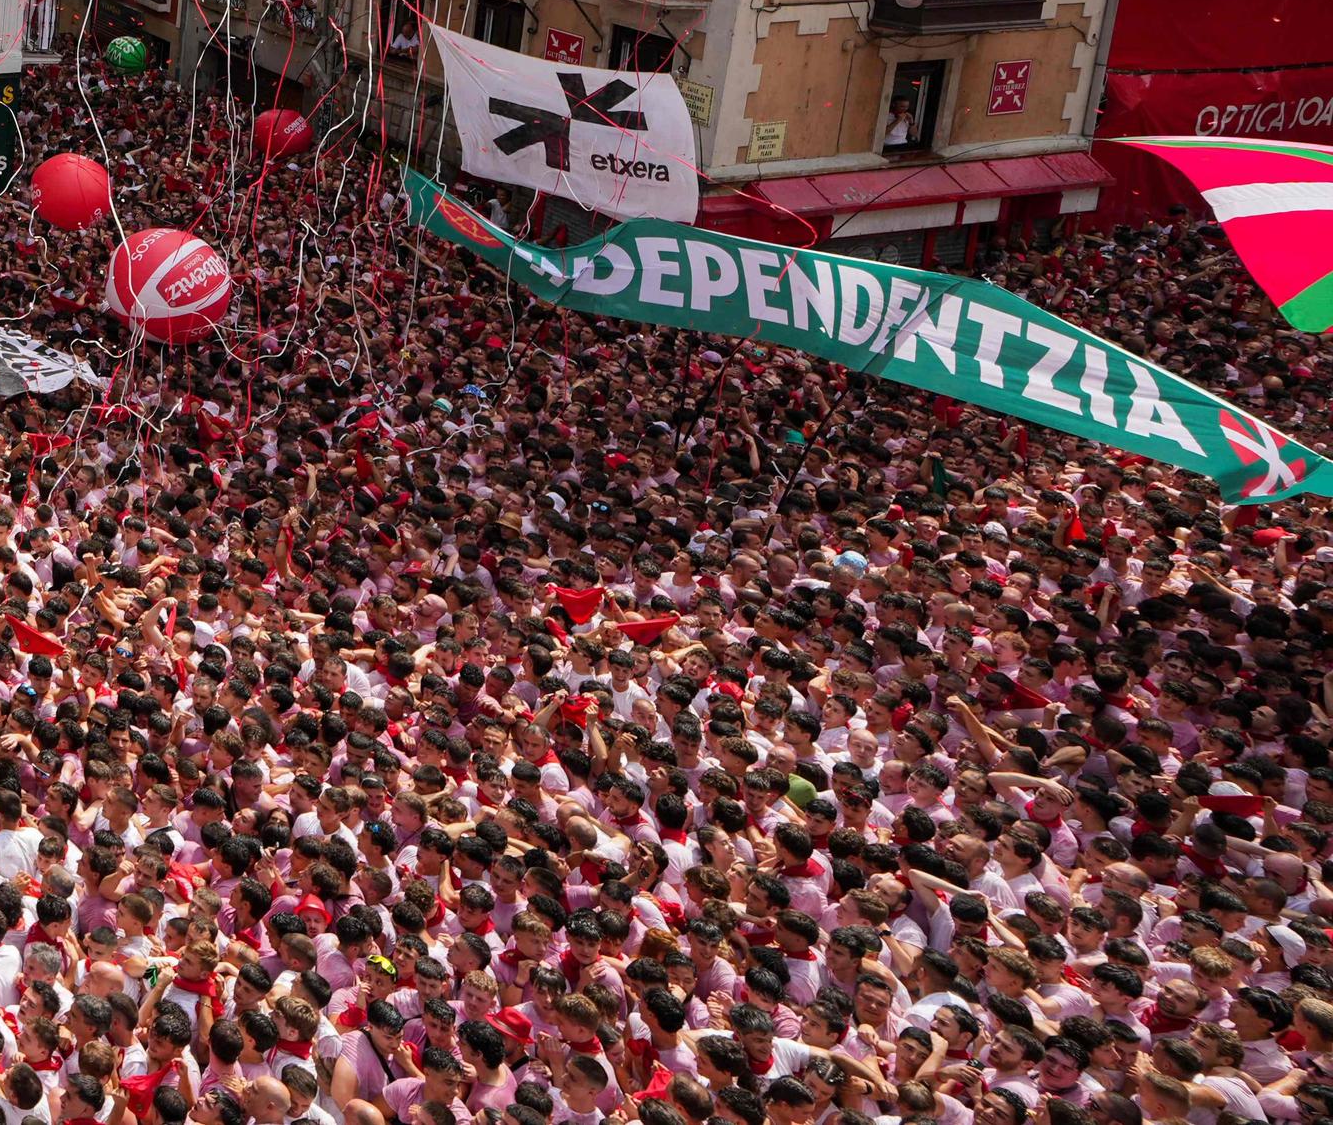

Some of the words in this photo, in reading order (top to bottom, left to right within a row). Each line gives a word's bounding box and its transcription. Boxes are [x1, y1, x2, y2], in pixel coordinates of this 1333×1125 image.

[1195, 101, 1286, 136] OPTICA
[590, 151, 671, 183] etxera
[131, 229, 177, 262] UESOS
